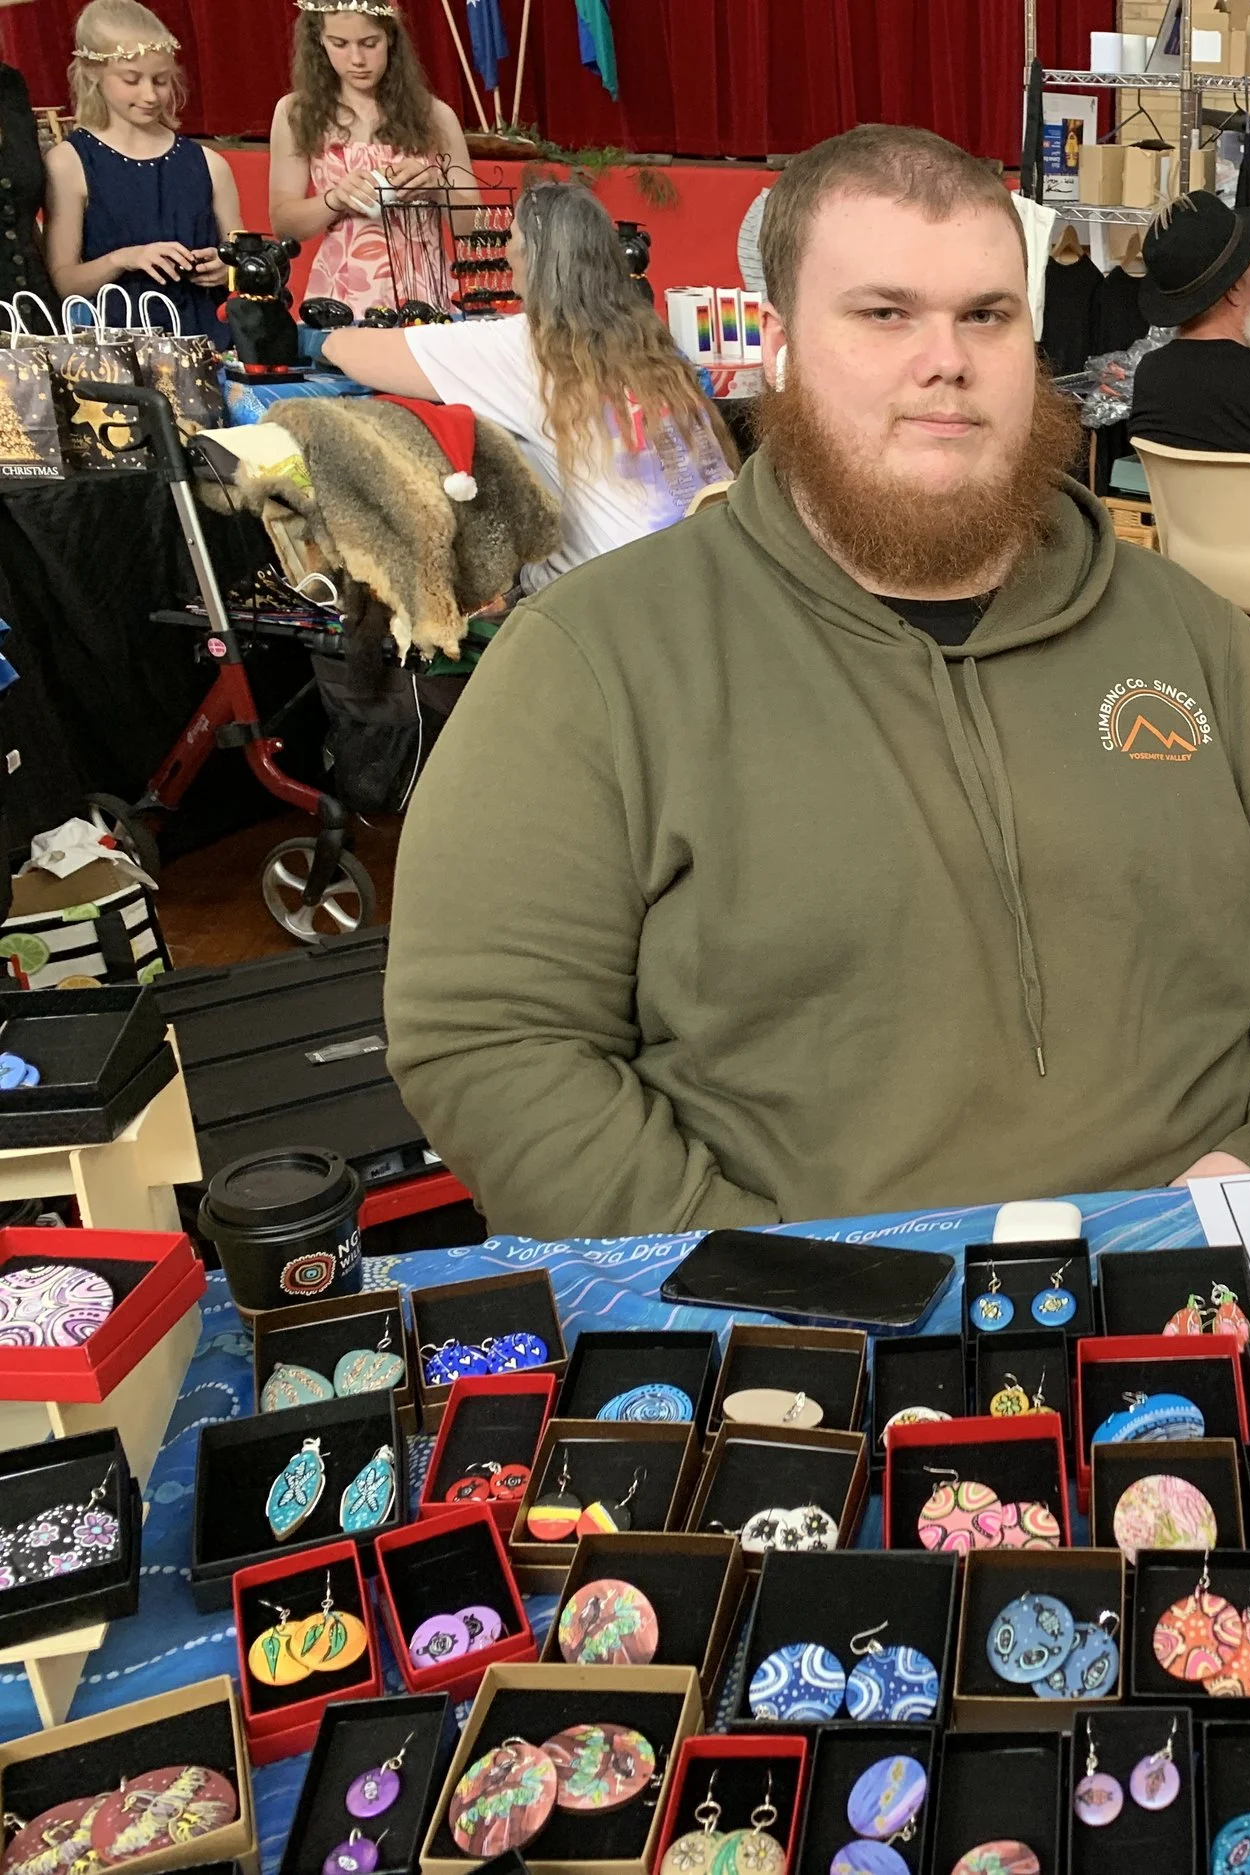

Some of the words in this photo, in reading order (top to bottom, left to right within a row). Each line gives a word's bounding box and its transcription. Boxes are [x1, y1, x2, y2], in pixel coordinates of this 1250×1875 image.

[2, 466, 59, 476] CHRISTMAS
[1098, 683, 1126, 751] CLIMBING
[1126, 678, 1148, 689] Co.
[1153, 679, 1197, 710] SINCE
[1193, 708, 1213, 745] 1994
[1129, 753, 1164, 761] YOSEMITE
[1165, 753, 1192, 762] VALLEY
[630, 1242, 673, 1262] Dja
